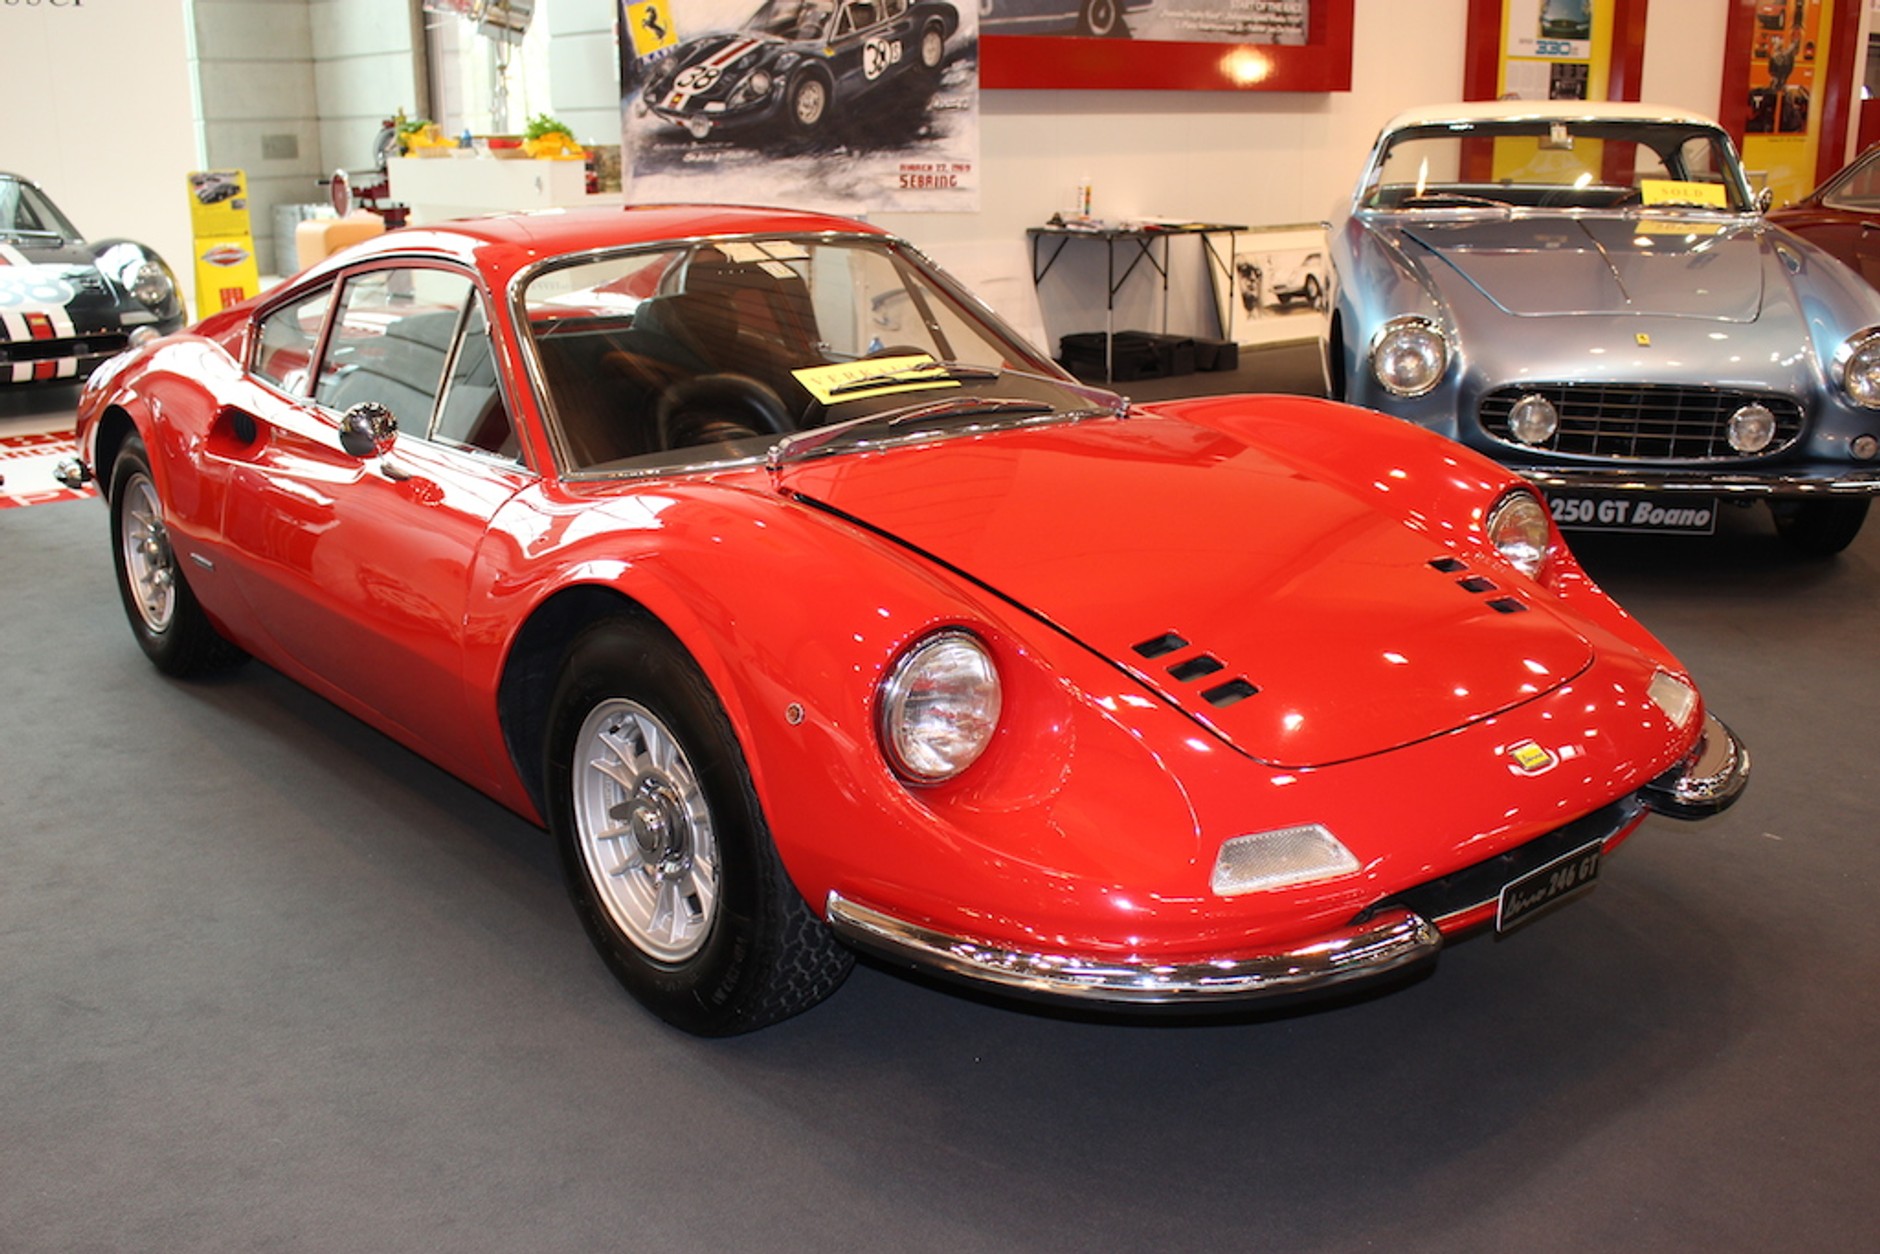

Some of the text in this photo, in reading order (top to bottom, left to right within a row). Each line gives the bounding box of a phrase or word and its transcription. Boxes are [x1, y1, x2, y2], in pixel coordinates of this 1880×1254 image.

[1536, 40, 1570, 55] 330
[677, 65, 721, 90] 38
[899, 174, 958, 190] SEBRING
[1661, 187, 1704, 199] SOLD
[1550, 499, 1711, 527] 250 GT Boano
[1579, 852, 1599, 880] GT
